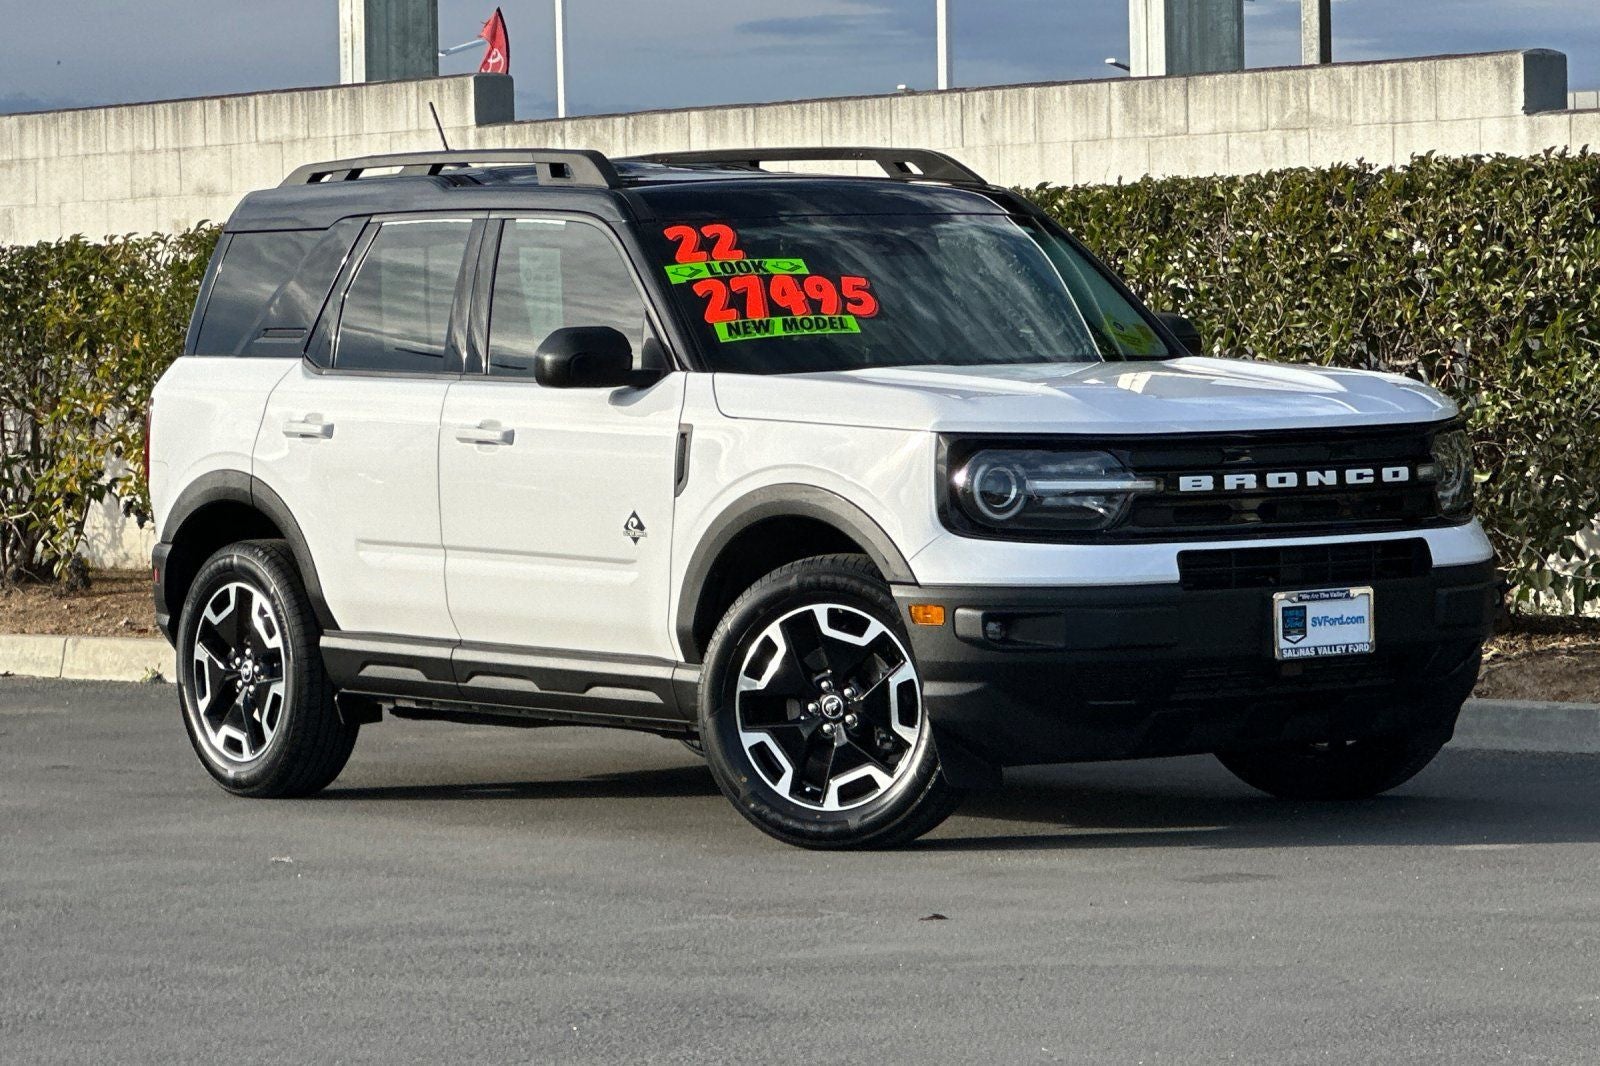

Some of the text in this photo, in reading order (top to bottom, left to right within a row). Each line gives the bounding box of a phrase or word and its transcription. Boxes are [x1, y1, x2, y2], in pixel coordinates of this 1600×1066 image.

[664, 223, 746, 264] 22
[706, 260, 769, 276] LOOK
[692, 274, 878, 324] 27495
[726, 317, 851, 339] NEW MODEL
[1179, 466, 1410, 492] BRONCO
[1311, 614, 1365, 628] SVFord.com
[1282, 643, 1370, 658] SALINAS VALLEY FORD
